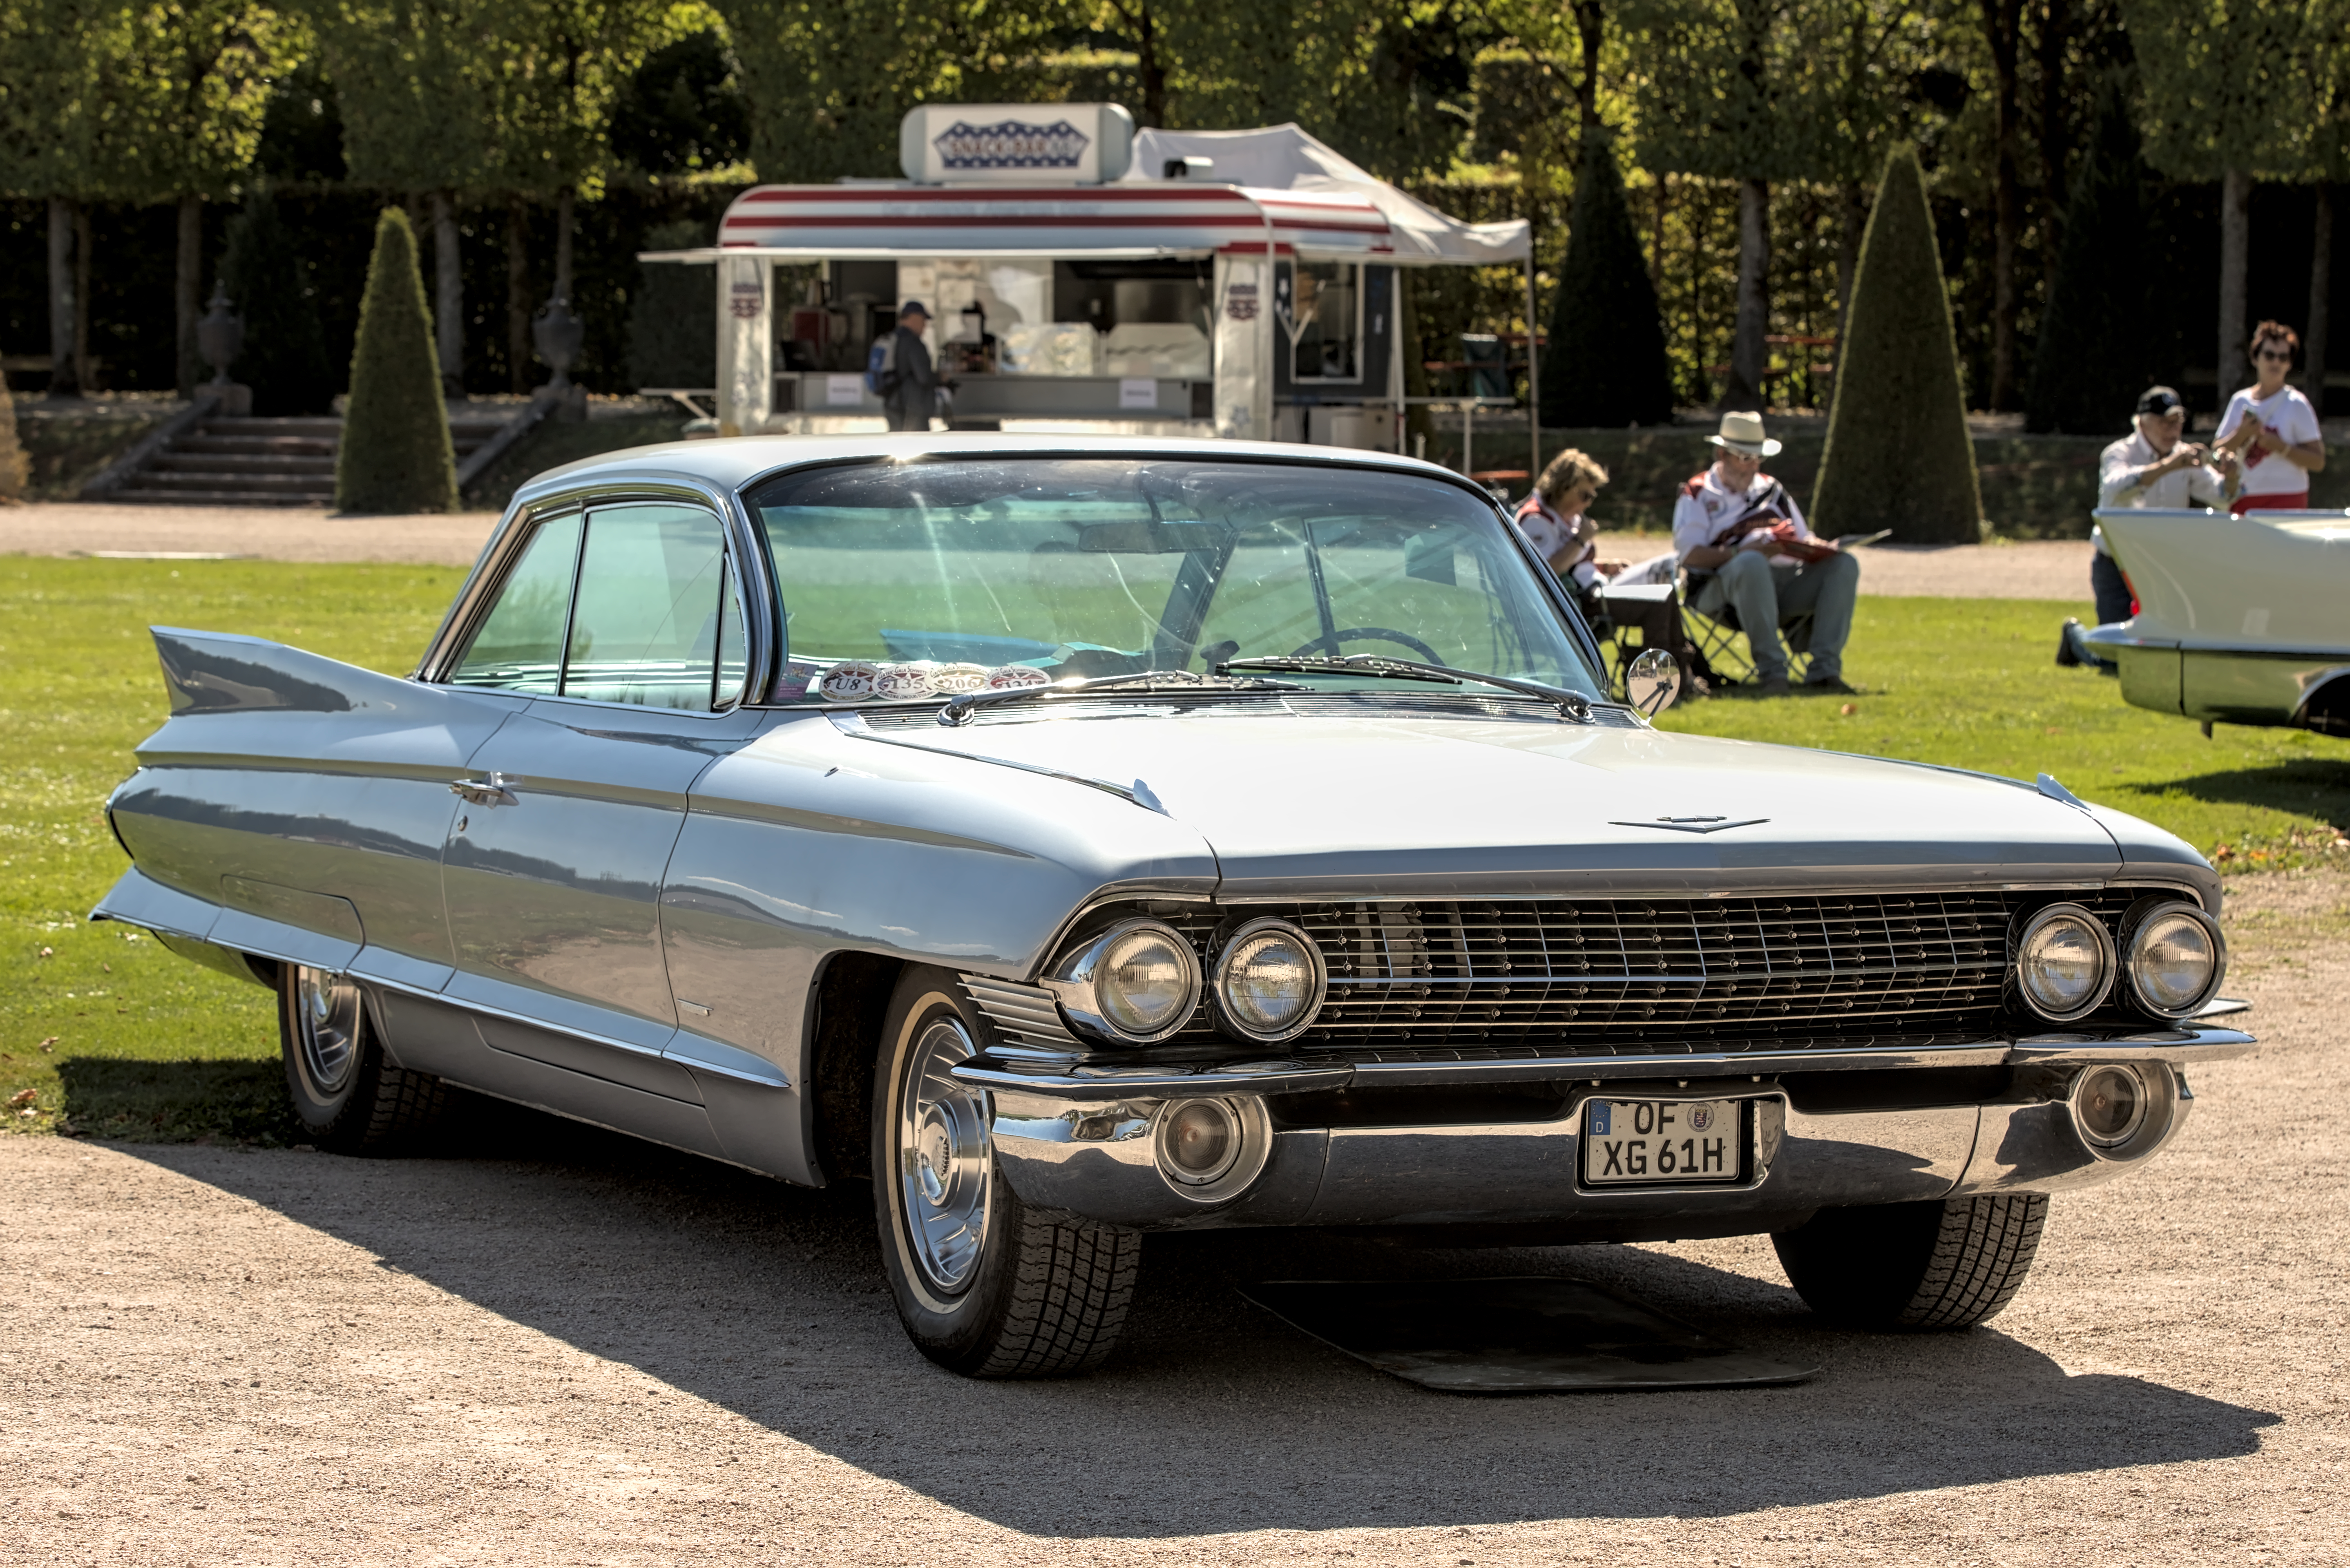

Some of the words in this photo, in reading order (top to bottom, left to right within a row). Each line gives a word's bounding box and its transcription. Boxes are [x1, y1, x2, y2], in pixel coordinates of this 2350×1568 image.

[835, 678, 861, 690] U8
[890, 678, 923, 689] 135
[945, 678, 978, 689] 206
[1635, 1102, 1678, 1134] OF
[1596, 1122, 1604, 1132] D
[1603, 1141, 1646, 1175] XG
[1658, 1138, 1722, 1173] 61H
